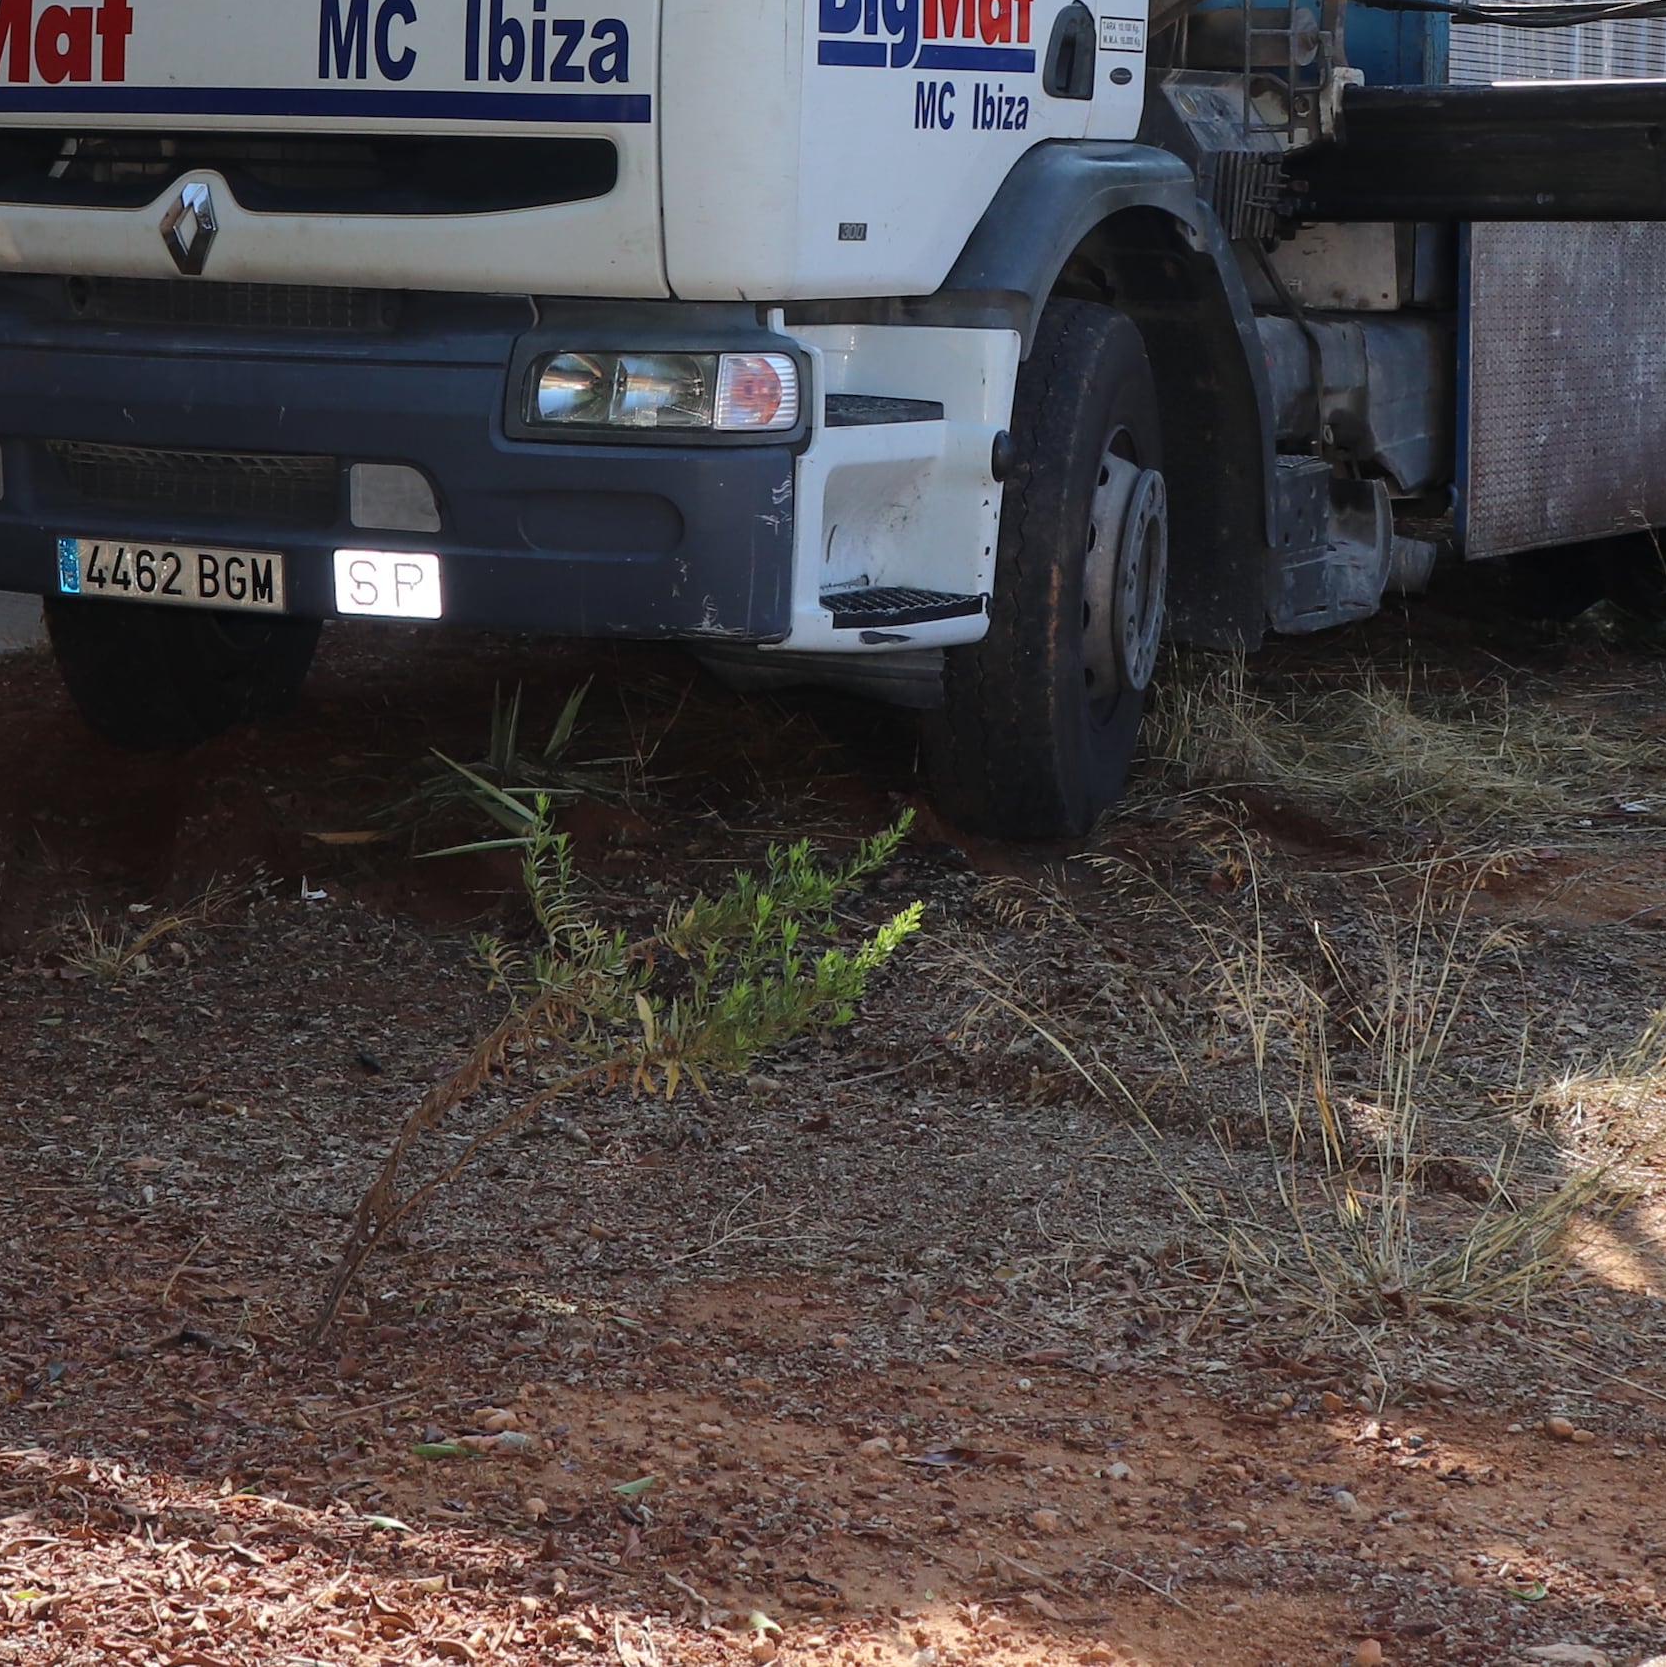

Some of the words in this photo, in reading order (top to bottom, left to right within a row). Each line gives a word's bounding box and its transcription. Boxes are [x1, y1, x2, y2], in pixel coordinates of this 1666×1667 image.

[914, 81, 955, 130] MC
[972, 82, 1029, 130] Ibiza
[86, 546, 182, 596] 4462
[198, 554, 273, 603] BGM
[349, 560, 424, 609] SP
